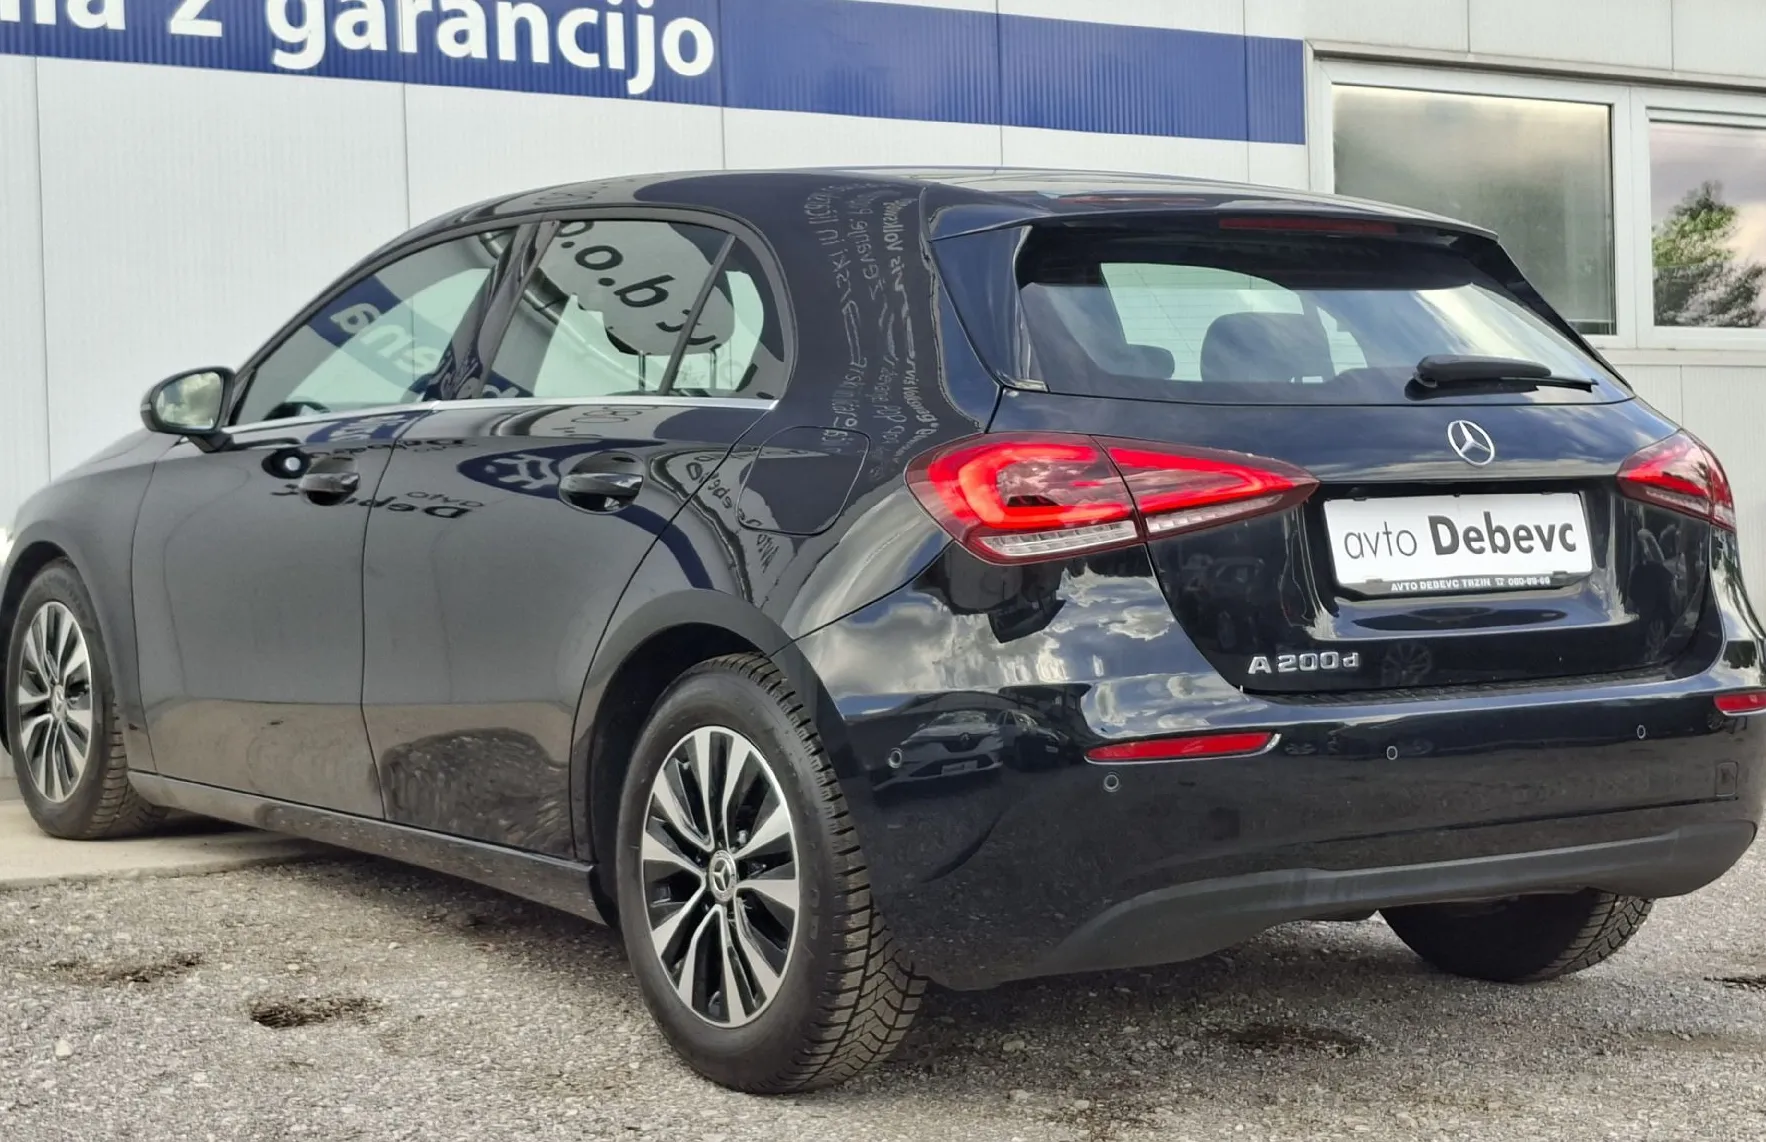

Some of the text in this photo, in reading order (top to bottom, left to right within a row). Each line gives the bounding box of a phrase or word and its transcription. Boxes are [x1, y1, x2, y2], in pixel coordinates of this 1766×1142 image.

[266, 0, 714, 95] garancijo
[1343, 511, 1578, 559] avto Debevc
[1391, 582, 1418, 593] AVTO
[1420, 579, 1460, 591] DEBEVC
[1248, 656, 1272, 675] A
